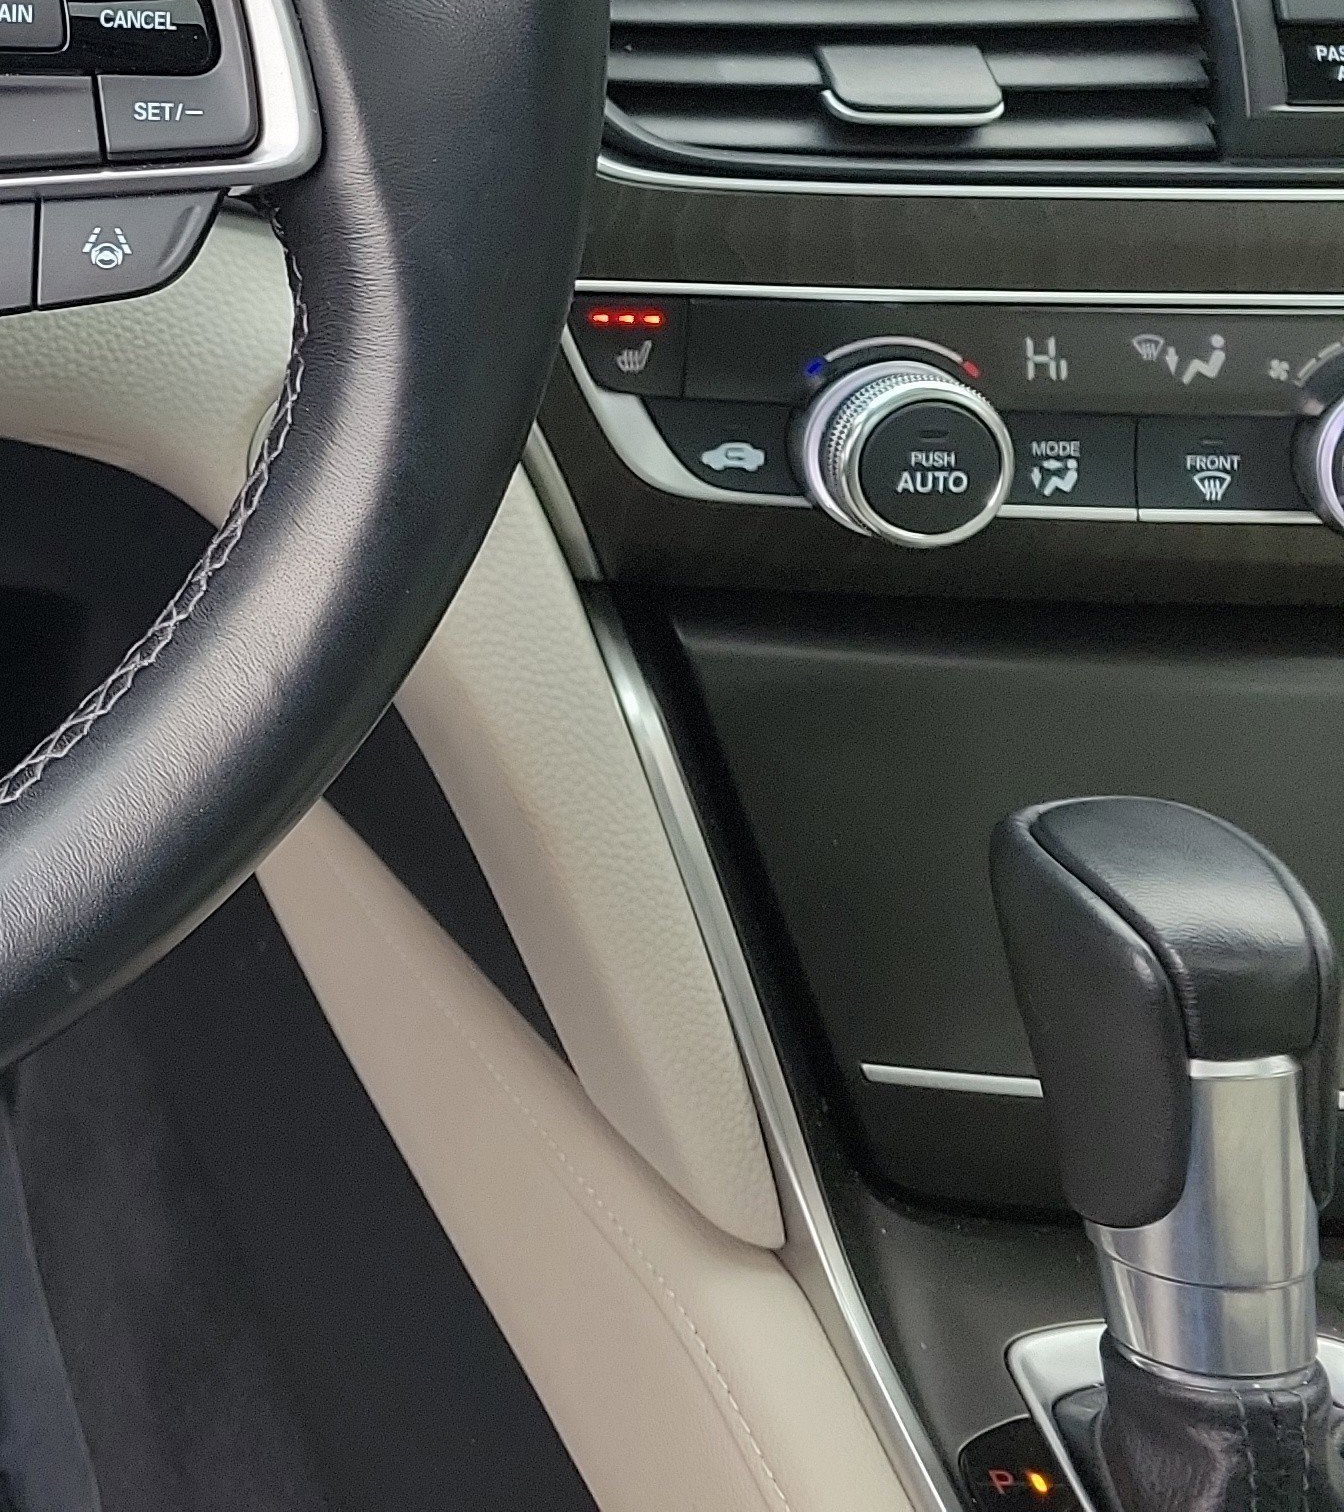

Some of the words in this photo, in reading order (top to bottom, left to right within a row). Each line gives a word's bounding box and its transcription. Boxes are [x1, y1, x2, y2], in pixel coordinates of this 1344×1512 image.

[99, 8, 178, 31] CANCEL
[1031, 441, 1081, 458] MODE
[911, 451, 957, 468] PUSH
[1186, 455, 1240, 472] FRONT
[896, 471, 969, 495] AUTO
